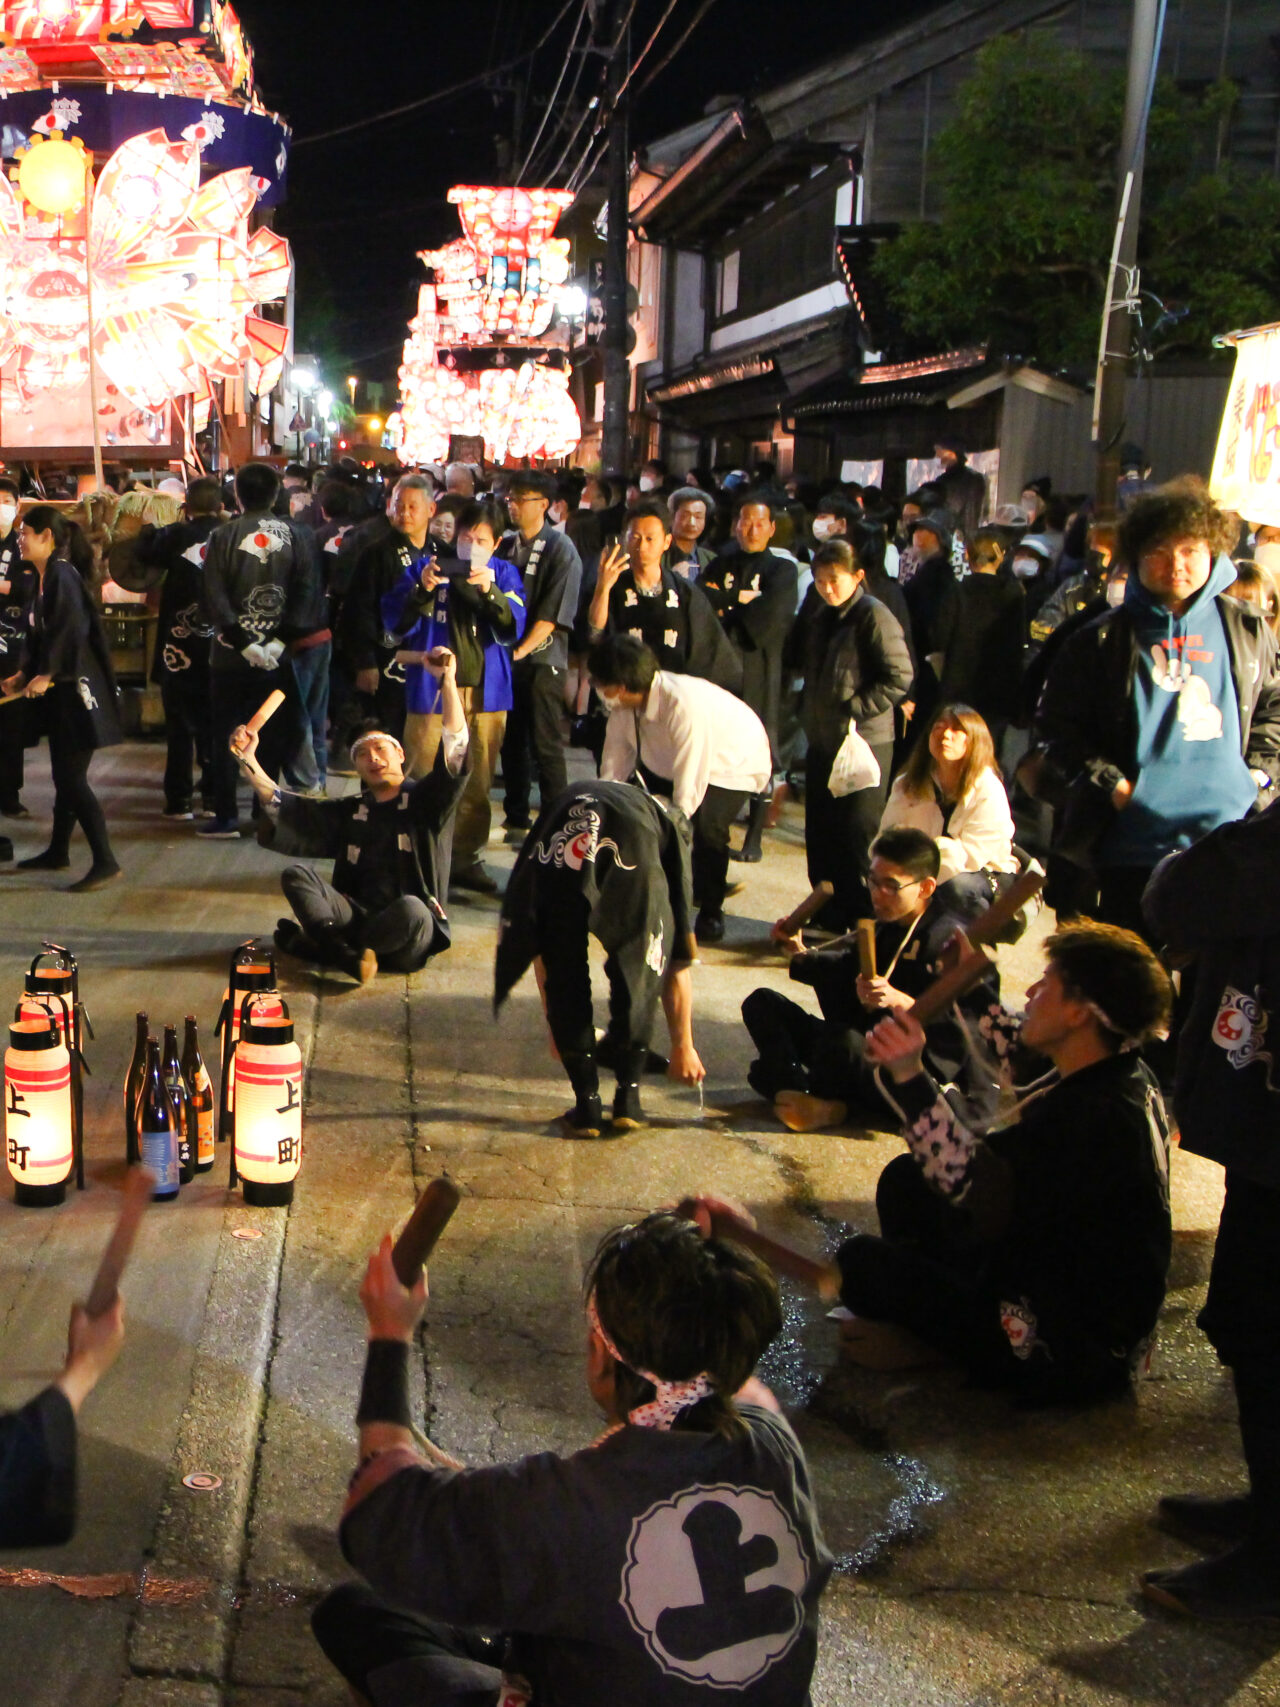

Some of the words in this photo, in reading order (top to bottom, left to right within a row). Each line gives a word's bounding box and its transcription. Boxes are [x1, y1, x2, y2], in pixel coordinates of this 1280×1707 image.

[7, 1082, 31, 1171] 上町
[275, 1079, 300, 1166] 上町
[655, 1499, 799, 1661] 上
